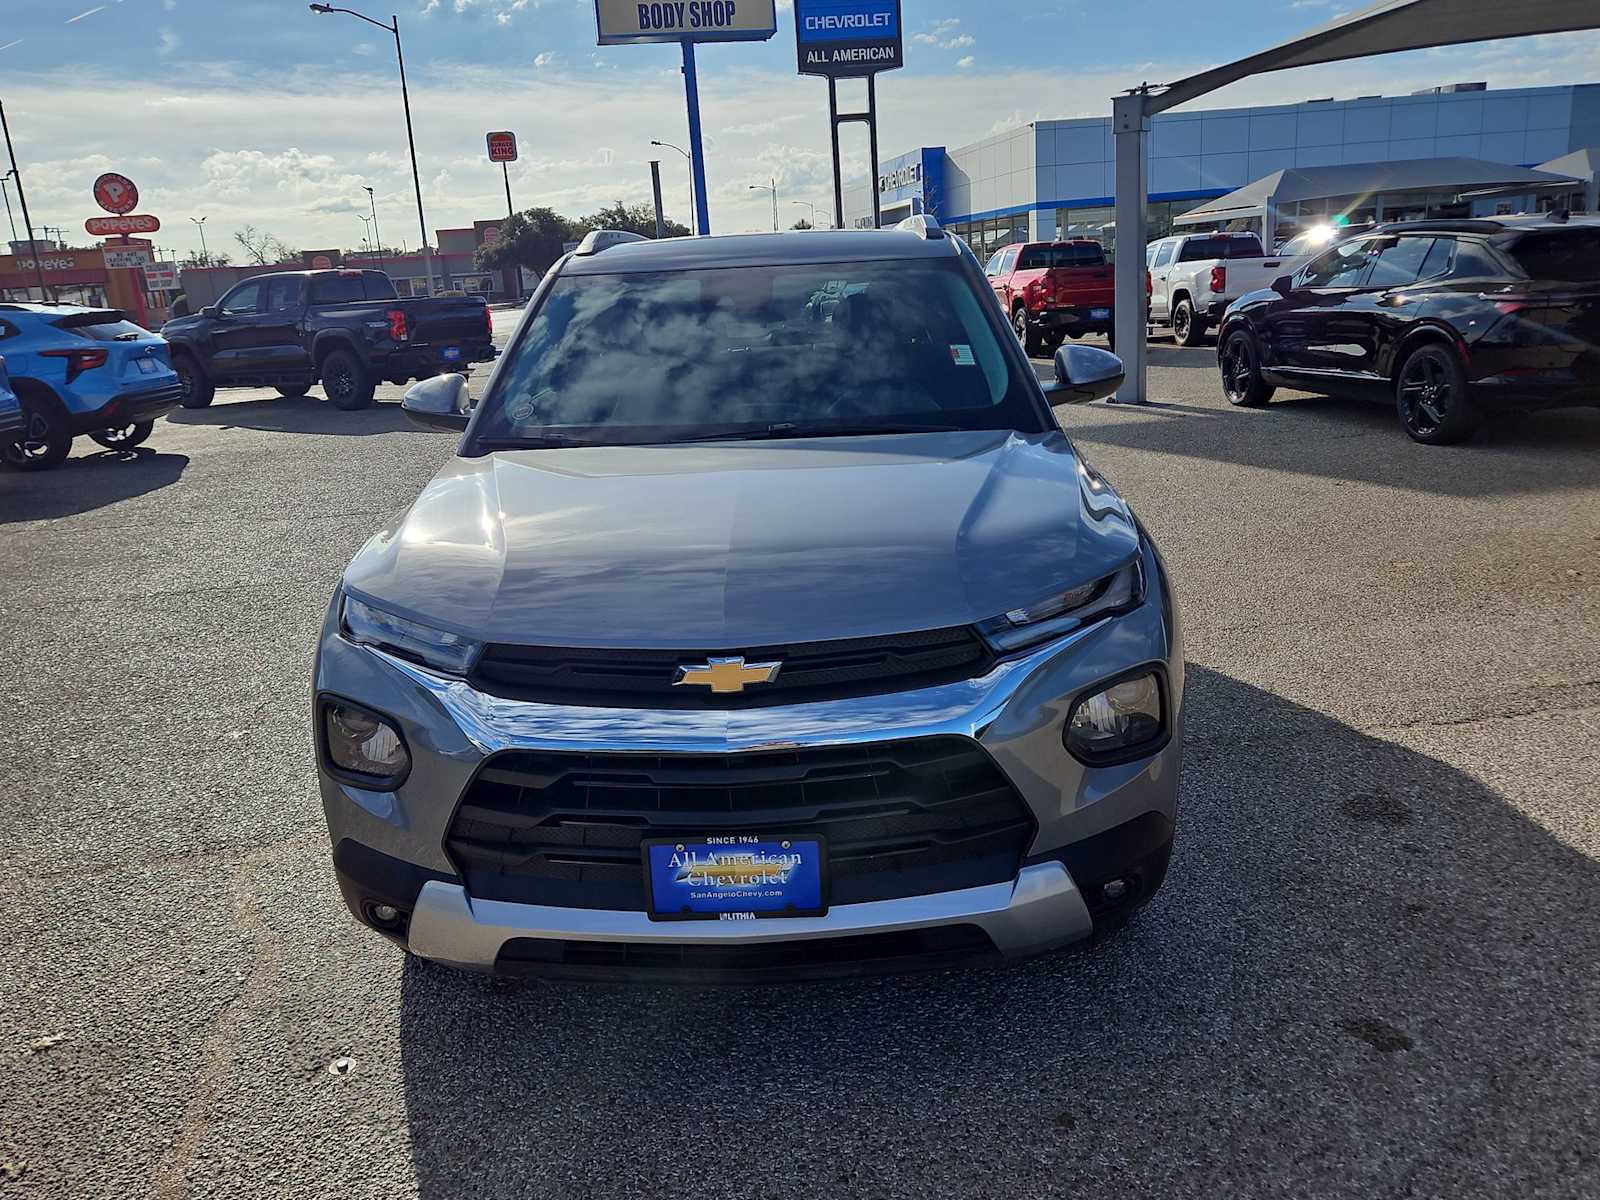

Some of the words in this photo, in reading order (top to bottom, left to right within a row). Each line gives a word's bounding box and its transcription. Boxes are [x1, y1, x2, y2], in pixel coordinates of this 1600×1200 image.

[638, 2, 687, 30] BODY
[689, 0, 736, 28] SHOP
[805, 12, 892, 30] CHEVROLET
[806, 50, 830, 64] ALL
[831, 46, 896, 63] AMERICAN
[706, 836, 736, 845] SINCE
[738, 835, 760, 844] 1946
[667, 851, 697, 868] All
[704, 850, 802, 866] American
[687, 870, 788, 887] Chevrolet
[690, 889, 783, 899] SanAngeloChevy.com
[727, 911, 756, 920] LITHIA
